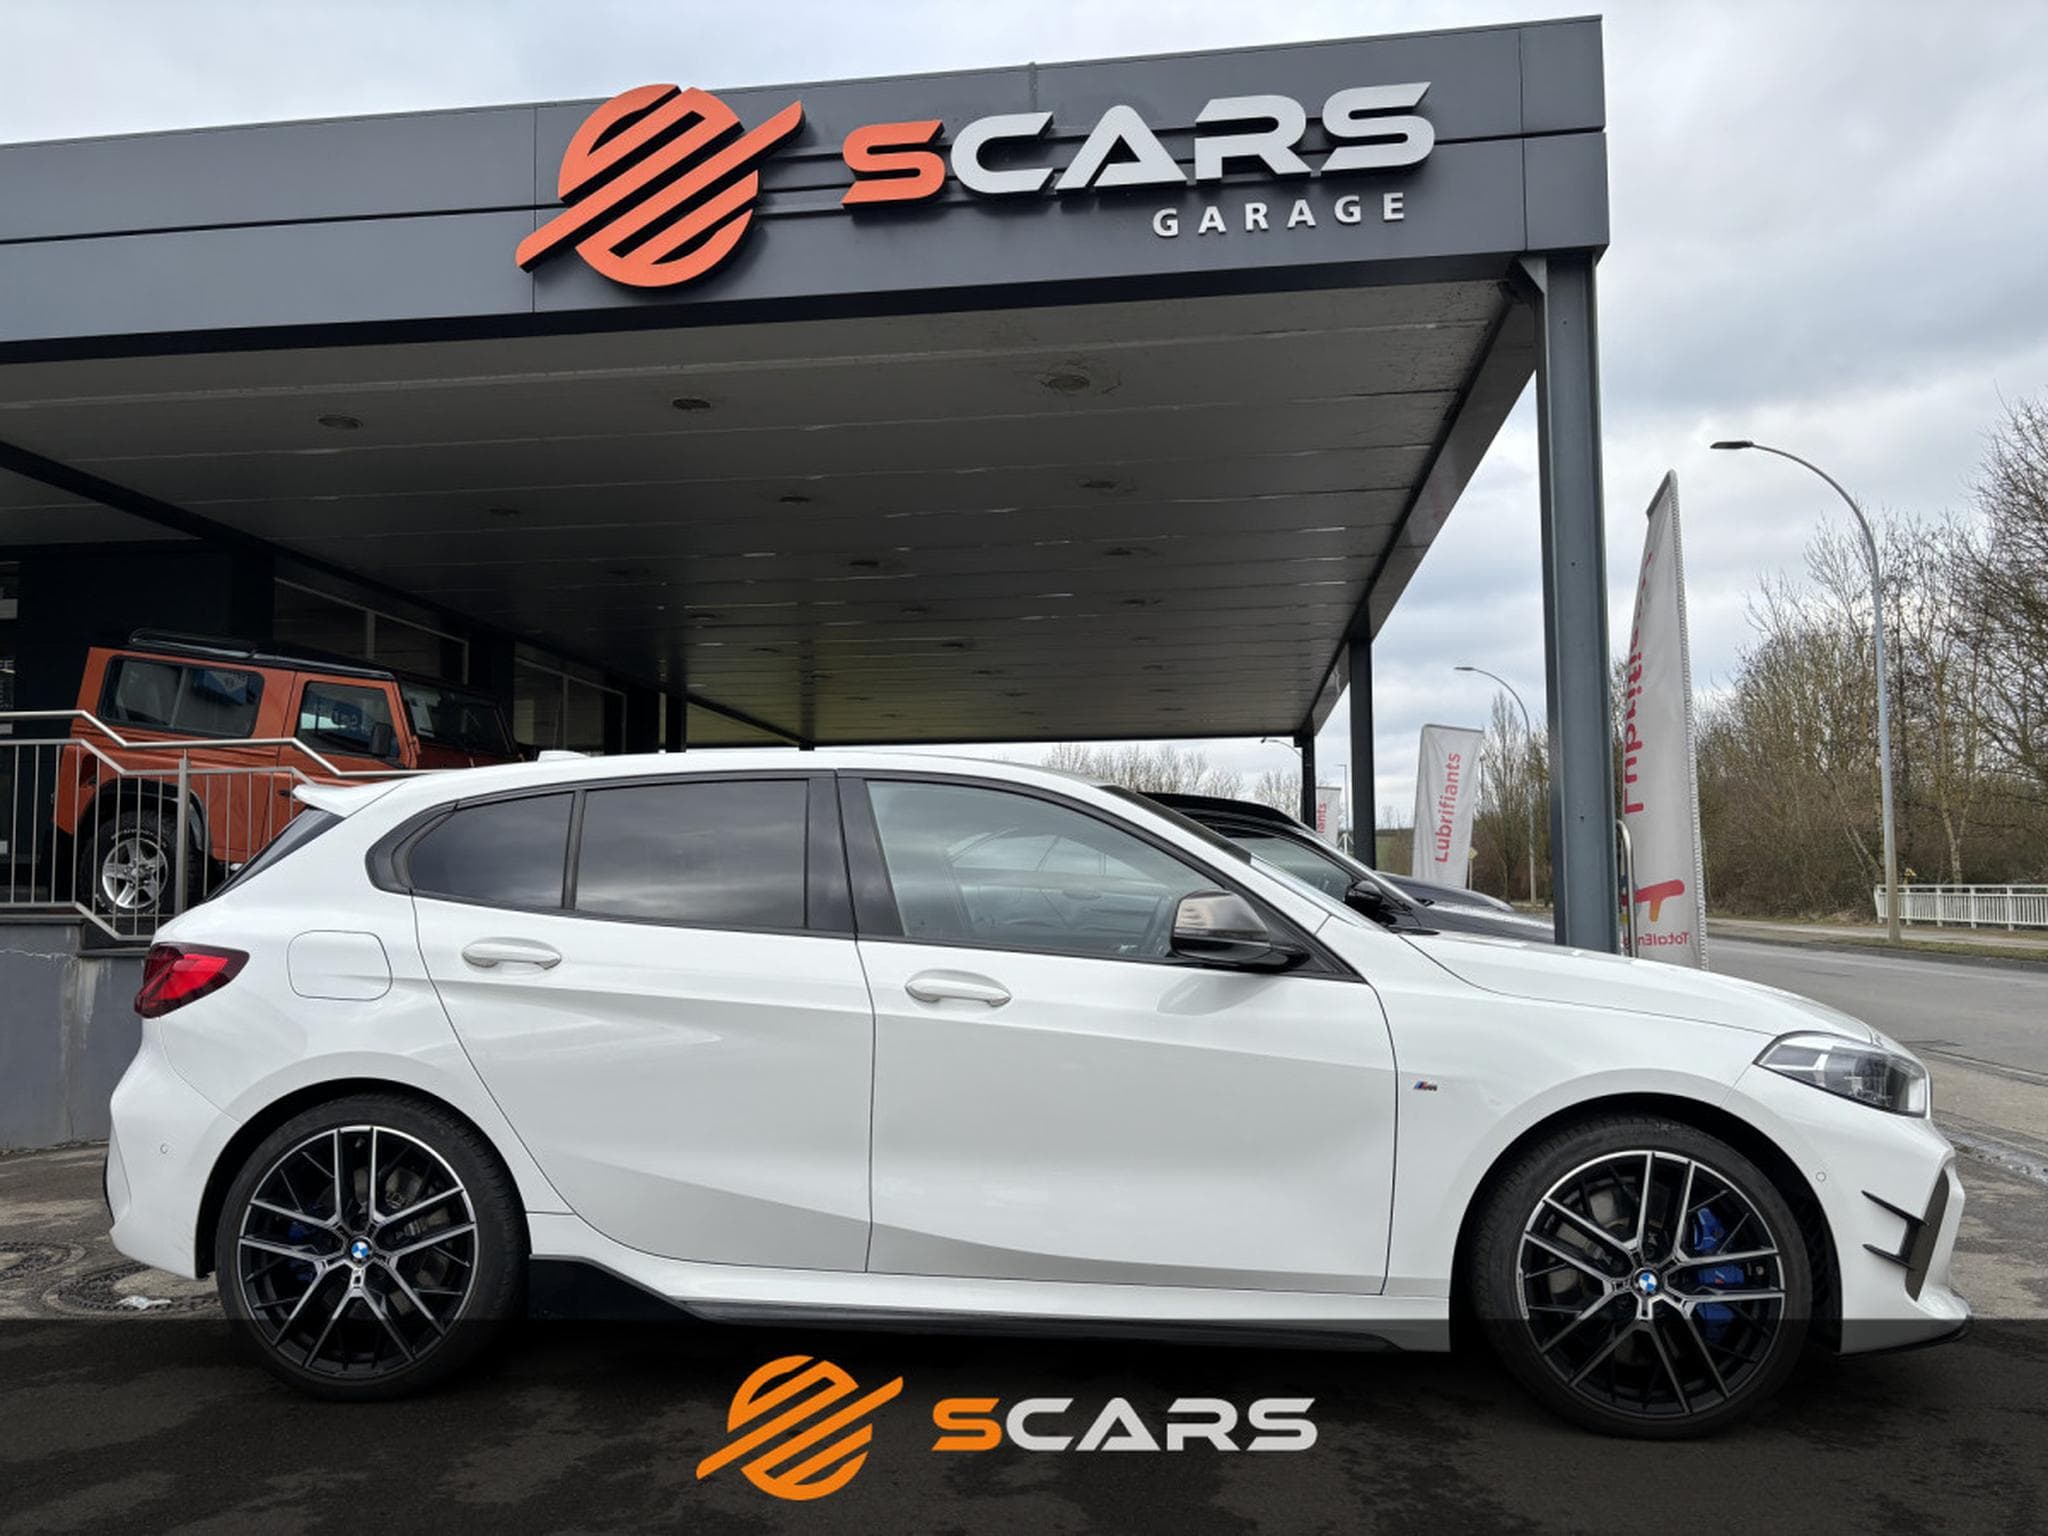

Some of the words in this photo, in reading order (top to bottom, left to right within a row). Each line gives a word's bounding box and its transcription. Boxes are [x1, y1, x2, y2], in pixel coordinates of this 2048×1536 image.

[841, 81, 1435, 206] SCARS
[1152, 192, 1405, 238] GARAGE
[1435, 753, 1461, 864] Lubrifiants
